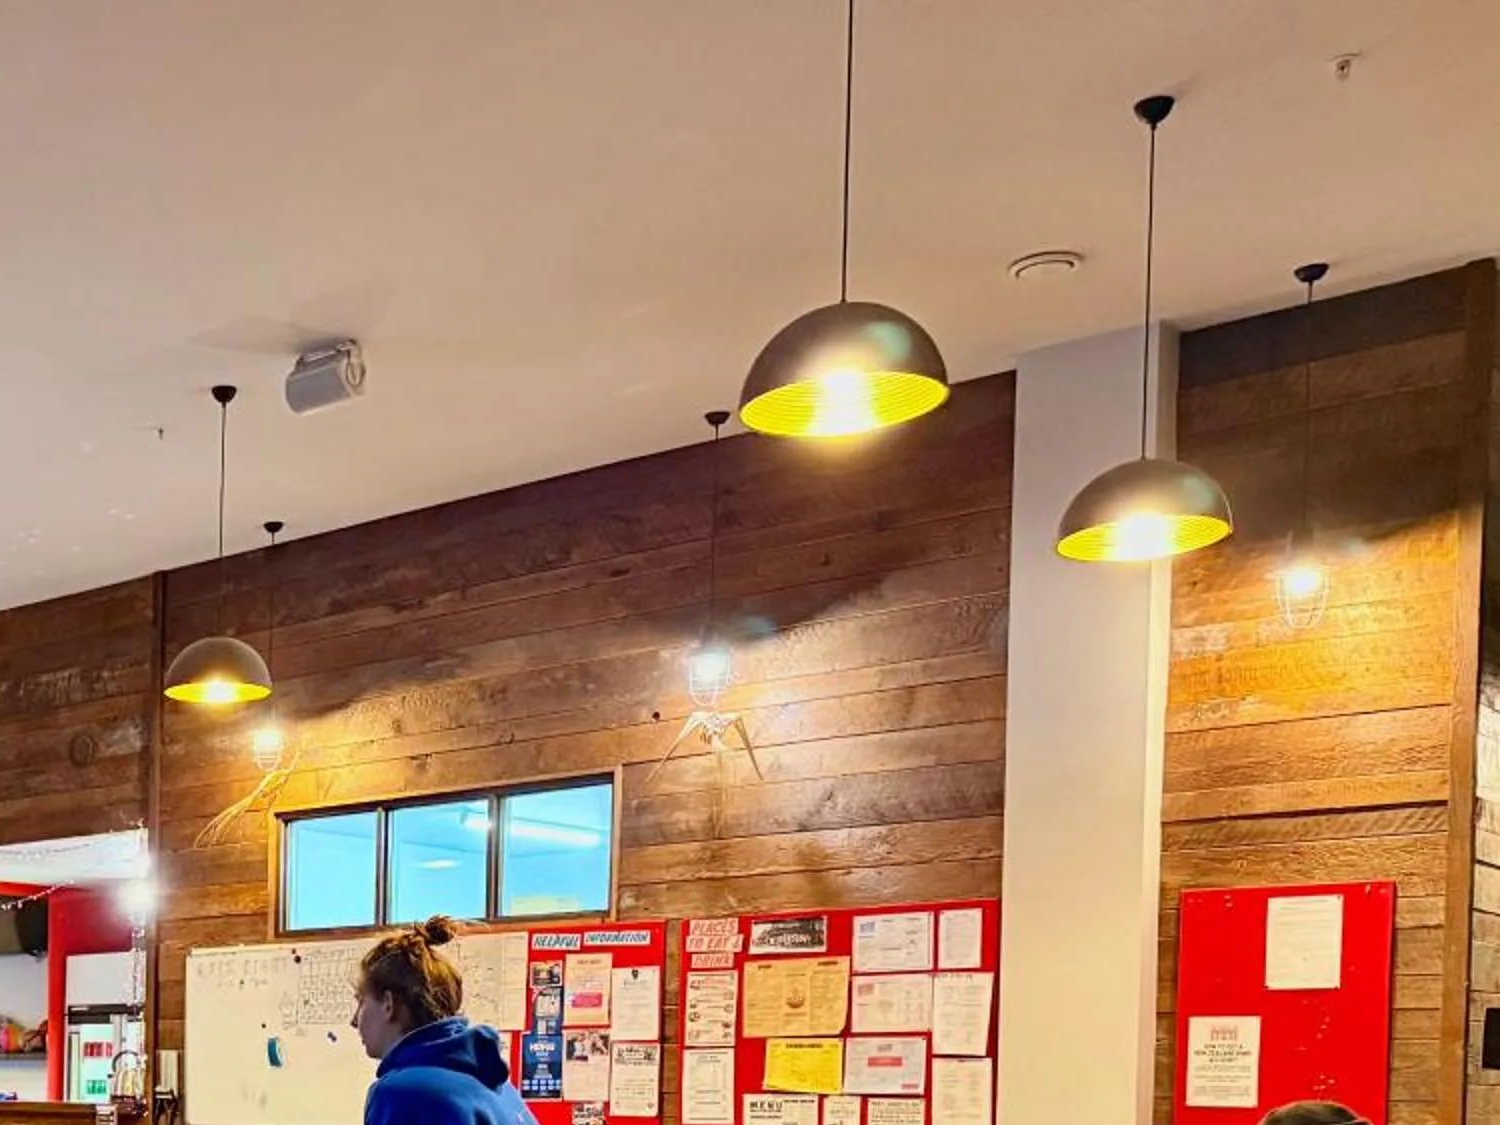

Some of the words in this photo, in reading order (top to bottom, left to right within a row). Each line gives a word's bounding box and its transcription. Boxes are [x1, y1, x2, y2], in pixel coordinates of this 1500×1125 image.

[692, 918, 736, 936] PLACES
[534, 934, 579, 948] HELPFUL
[749, 1101, 783, 1109] MENU
